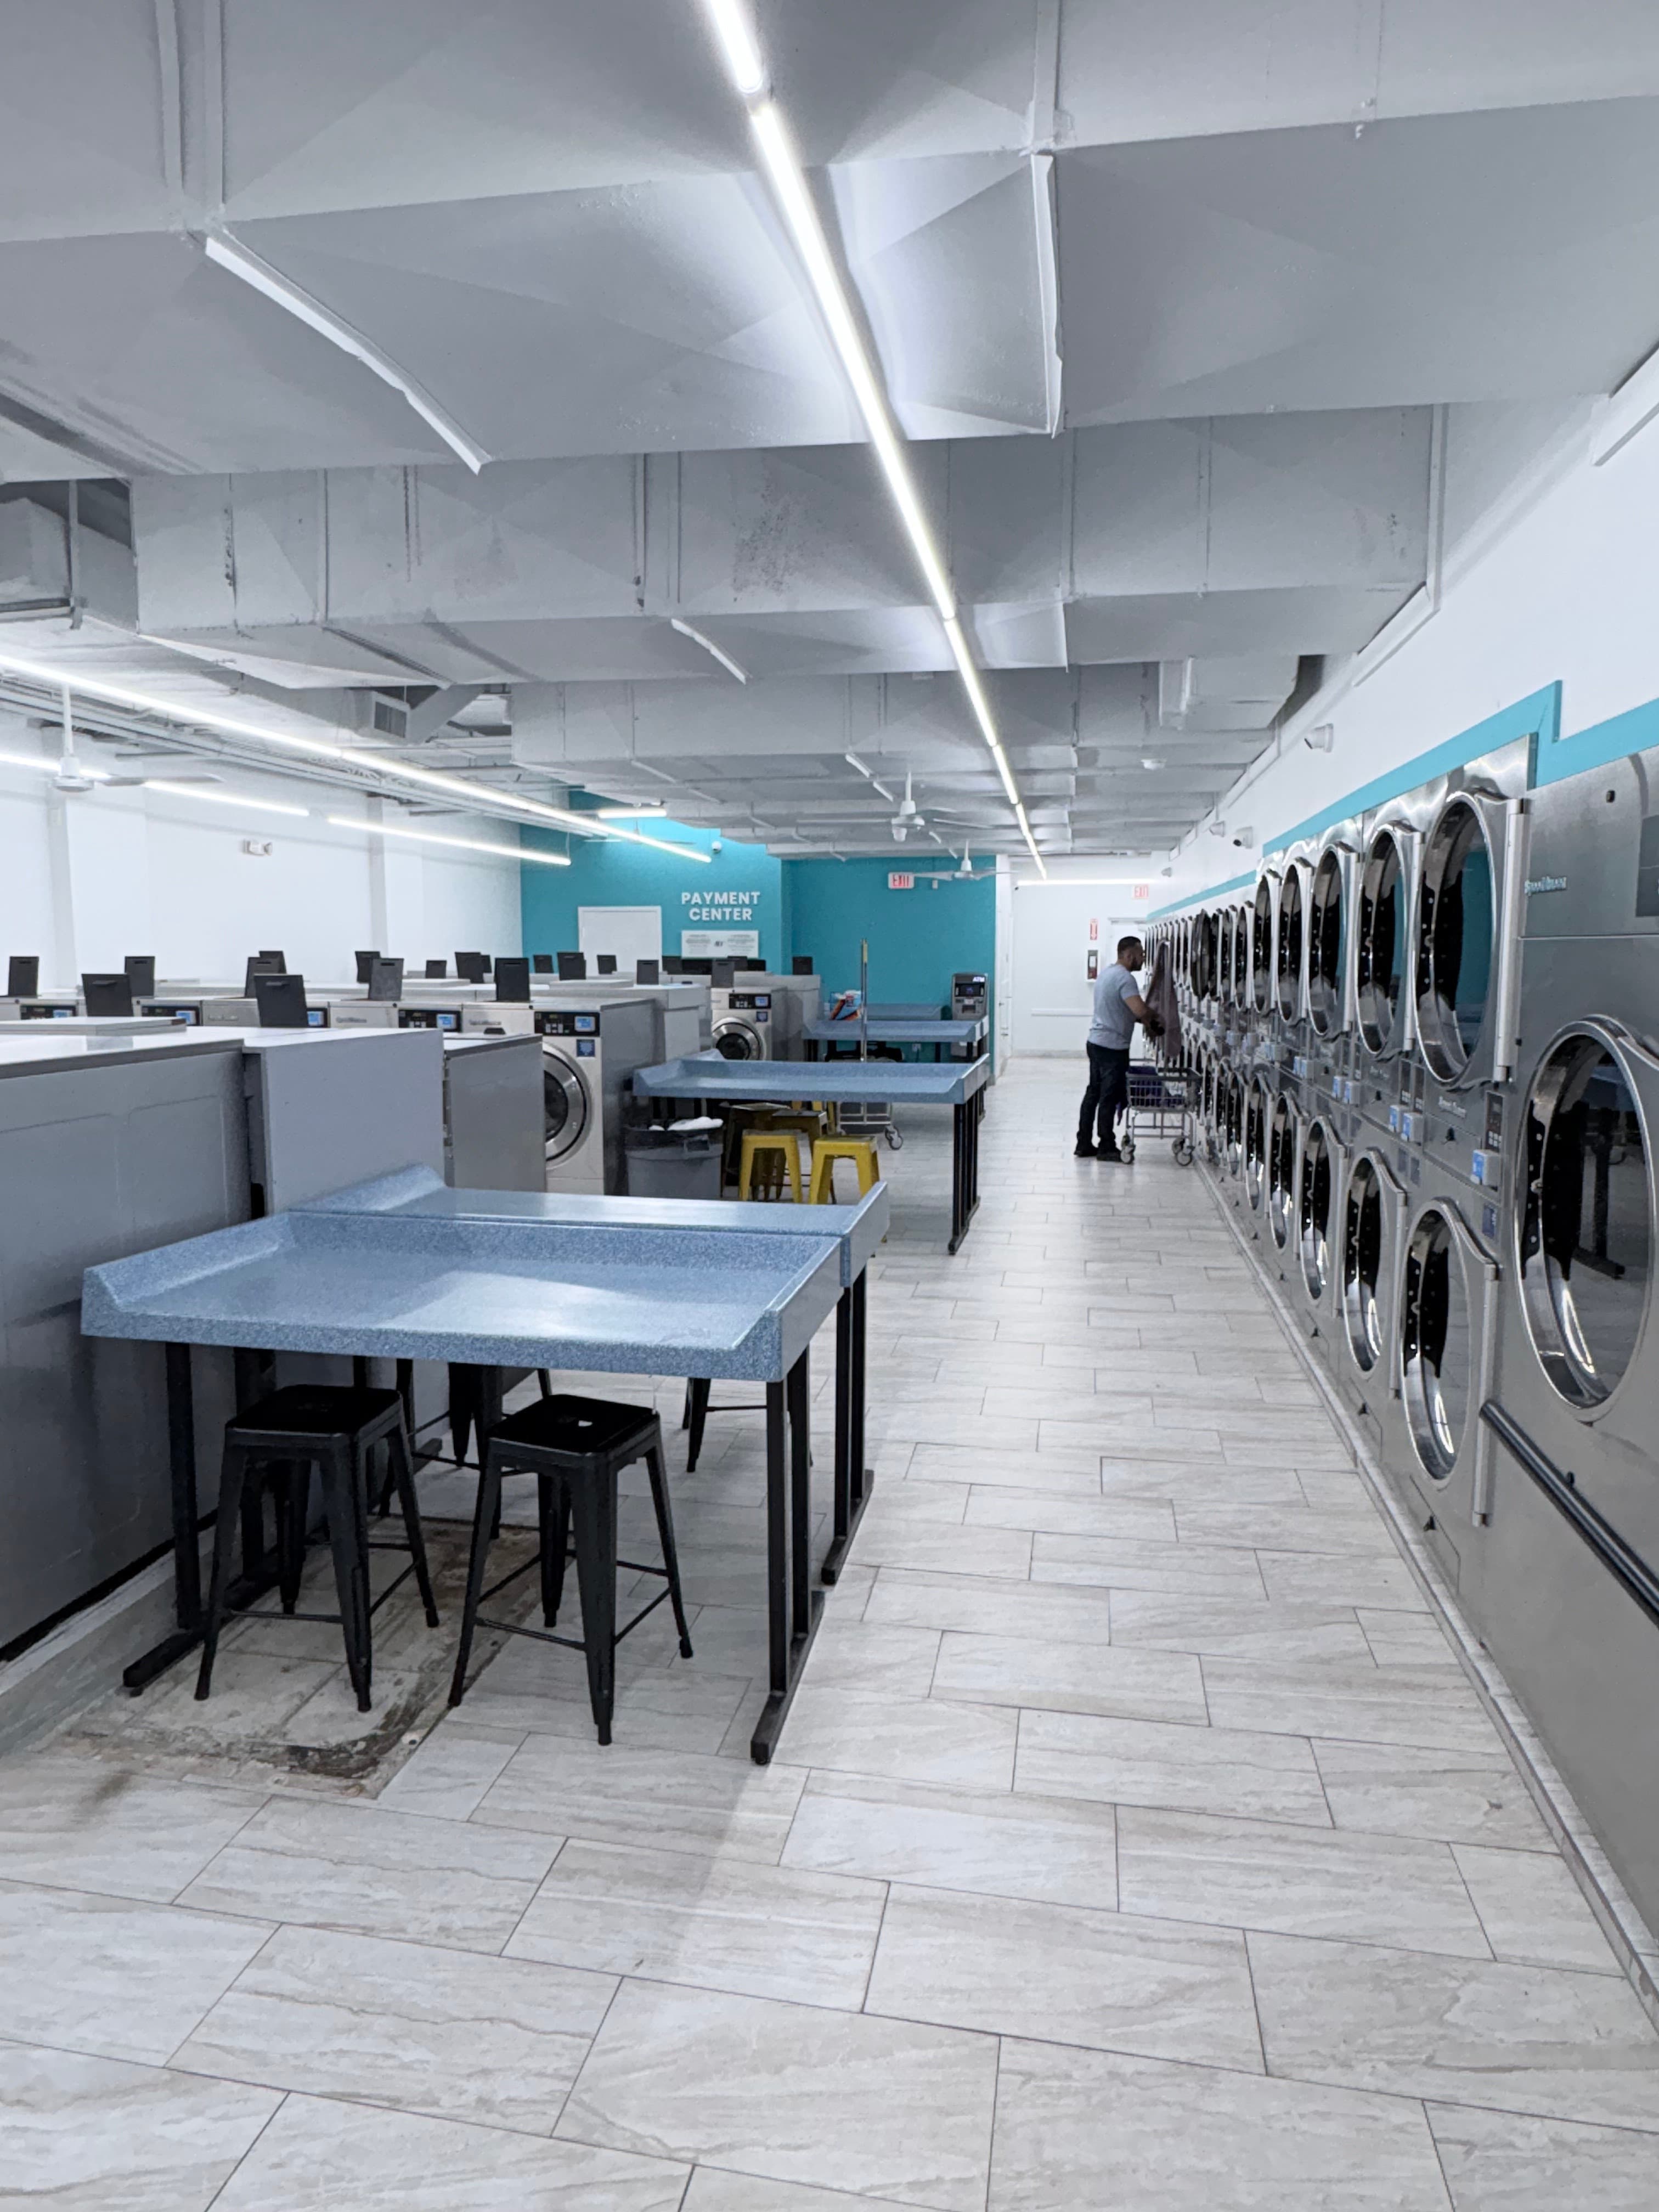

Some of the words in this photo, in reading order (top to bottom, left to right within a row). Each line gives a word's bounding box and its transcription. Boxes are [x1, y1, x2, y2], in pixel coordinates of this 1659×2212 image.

[892, 874, 910, 887] EXIT
[681, 891, 760, 905] PAYMENT
[689, 907, 752, 921] CENTER
